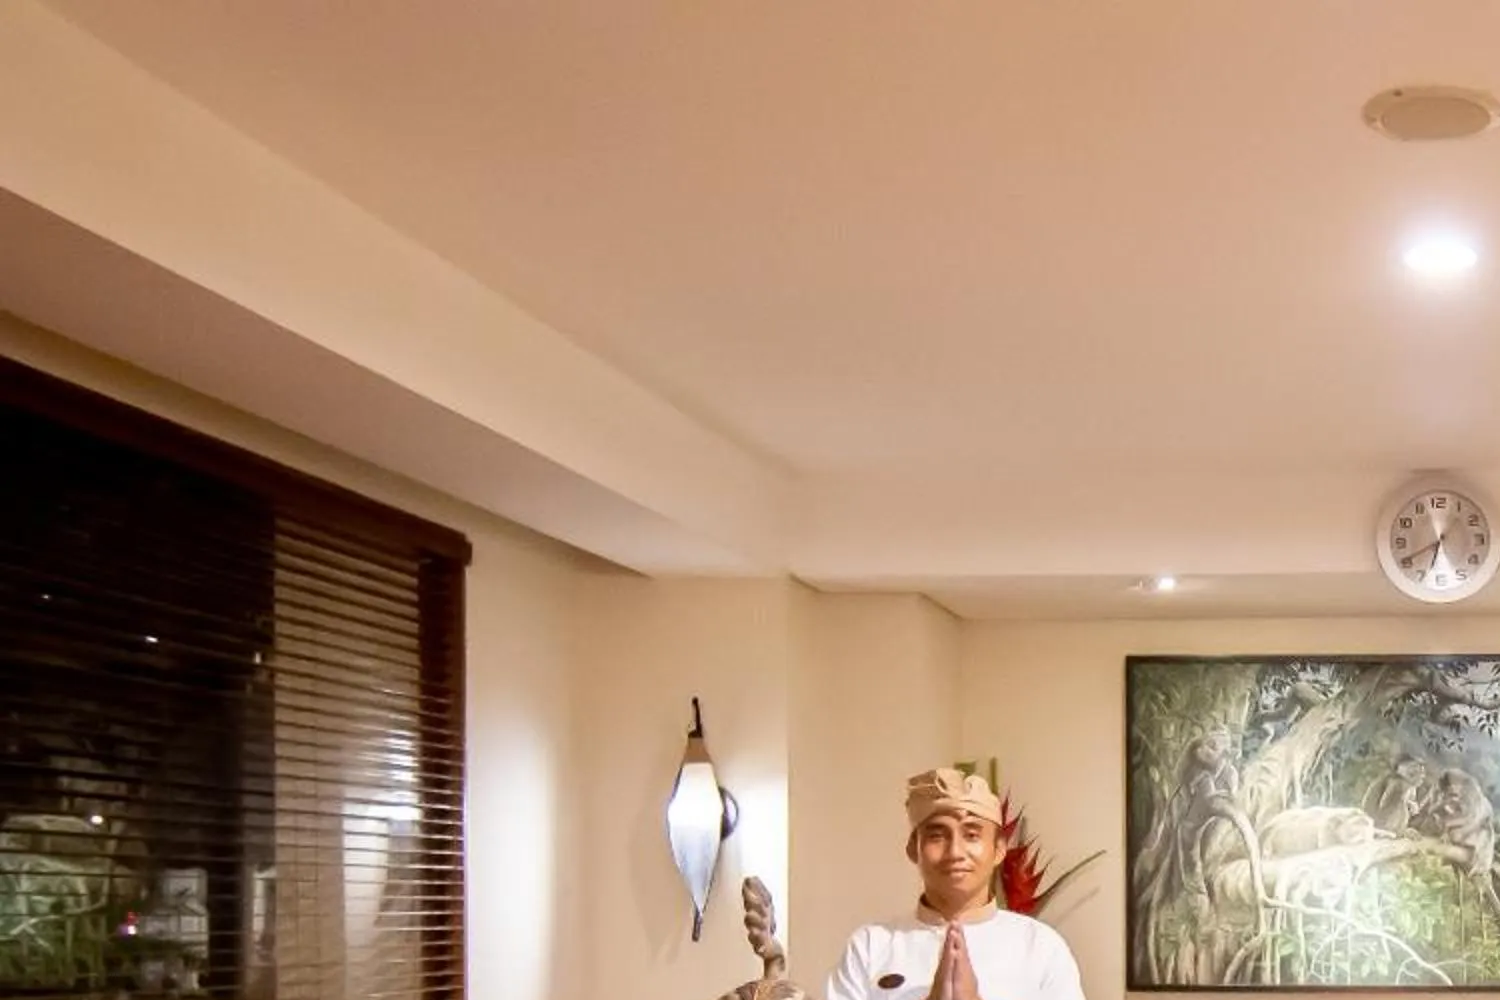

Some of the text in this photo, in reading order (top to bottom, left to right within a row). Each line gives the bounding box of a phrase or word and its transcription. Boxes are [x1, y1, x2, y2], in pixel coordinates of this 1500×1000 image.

[1431, 497, 1447, 509] 12
[1457, 501, 1461, 513] 1
[1399, 517, 1412, 529] 10
[1468, 514, 1479, 527] 2
[1395, 537, 1406, 549] 9
[1474, 533, 1485, 546] 3
[1467, 554, 1479, 565] 4
[1416, 570, 1426, 582] 7
[1455, 569, 1467, 580] 5
